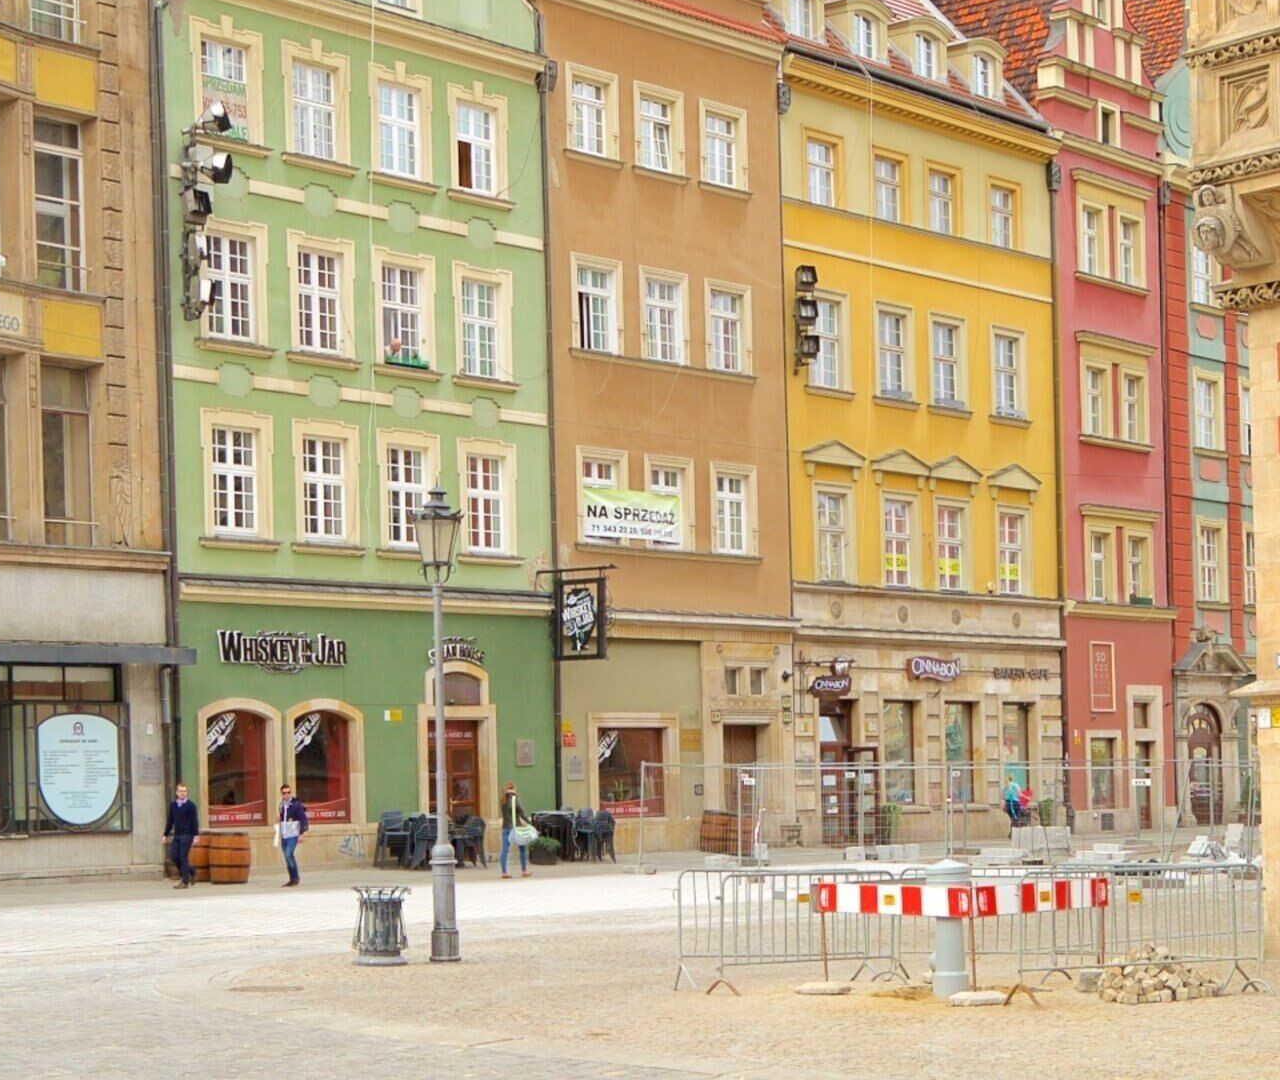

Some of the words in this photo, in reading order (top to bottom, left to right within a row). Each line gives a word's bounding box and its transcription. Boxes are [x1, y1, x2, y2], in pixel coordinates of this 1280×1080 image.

[587, 505, 608, 518] NA
[614, 507, 675, 525] SPRZEDAŻ
[217, 630, 300, 664] WHISKEY
[313, 633, 348, 665] JAR
[911, 658, 960, 677] CINNABON
[815, 678, 849, 691] CINNABON
